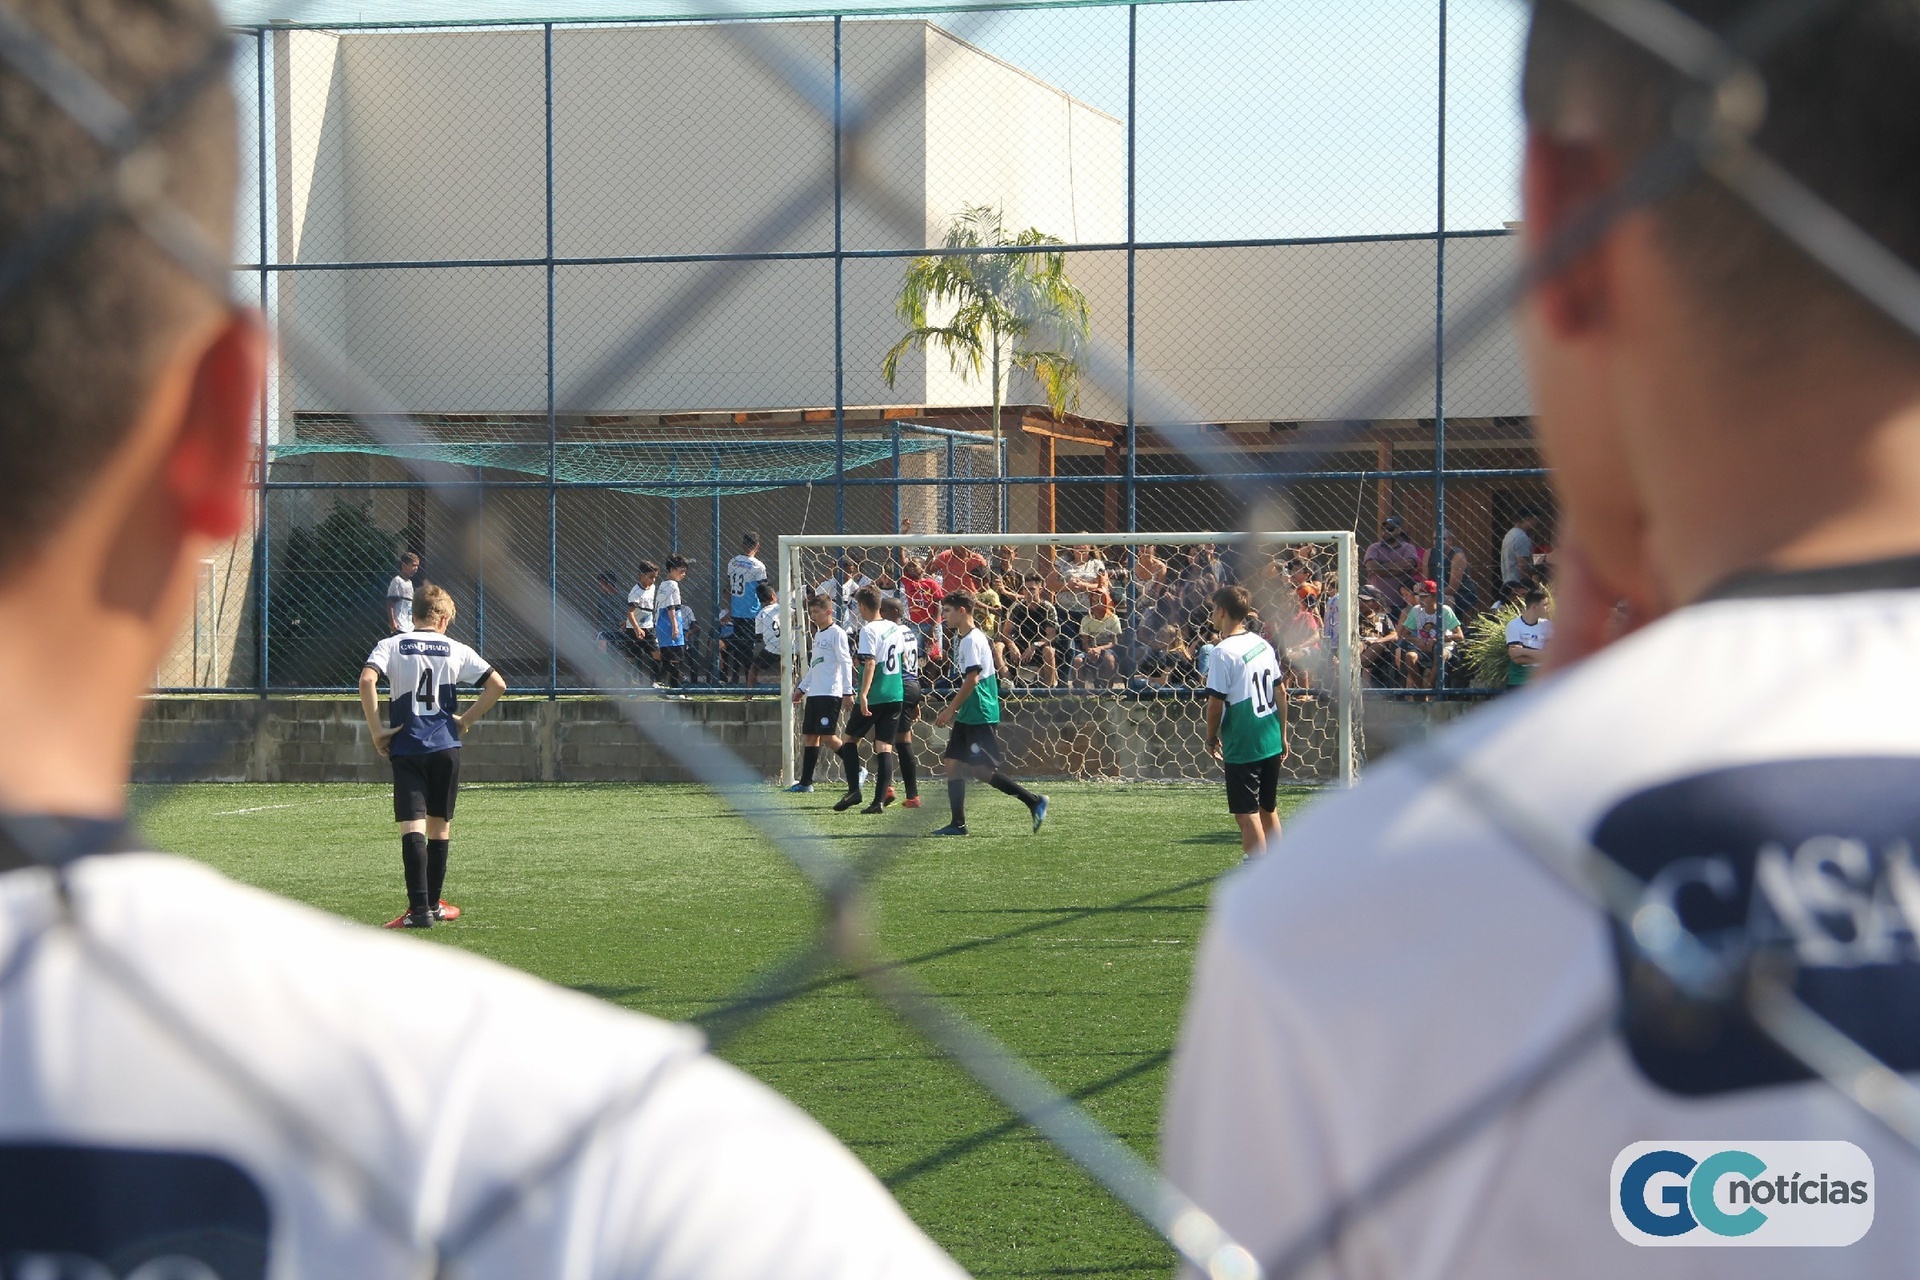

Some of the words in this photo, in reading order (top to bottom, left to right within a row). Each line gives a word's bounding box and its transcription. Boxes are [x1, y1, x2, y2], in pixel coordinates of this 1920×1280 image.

[731, 573, 744, 595] 13
[772, 621, 780, 638] 9
[401, 643, 419, 651] CASA
[425, 644, 449, 653] PRADO
[886, 644, 896, 672] 6
[416, 668, 435, 711] 4
[1252, 668, 1275, 714] 10
